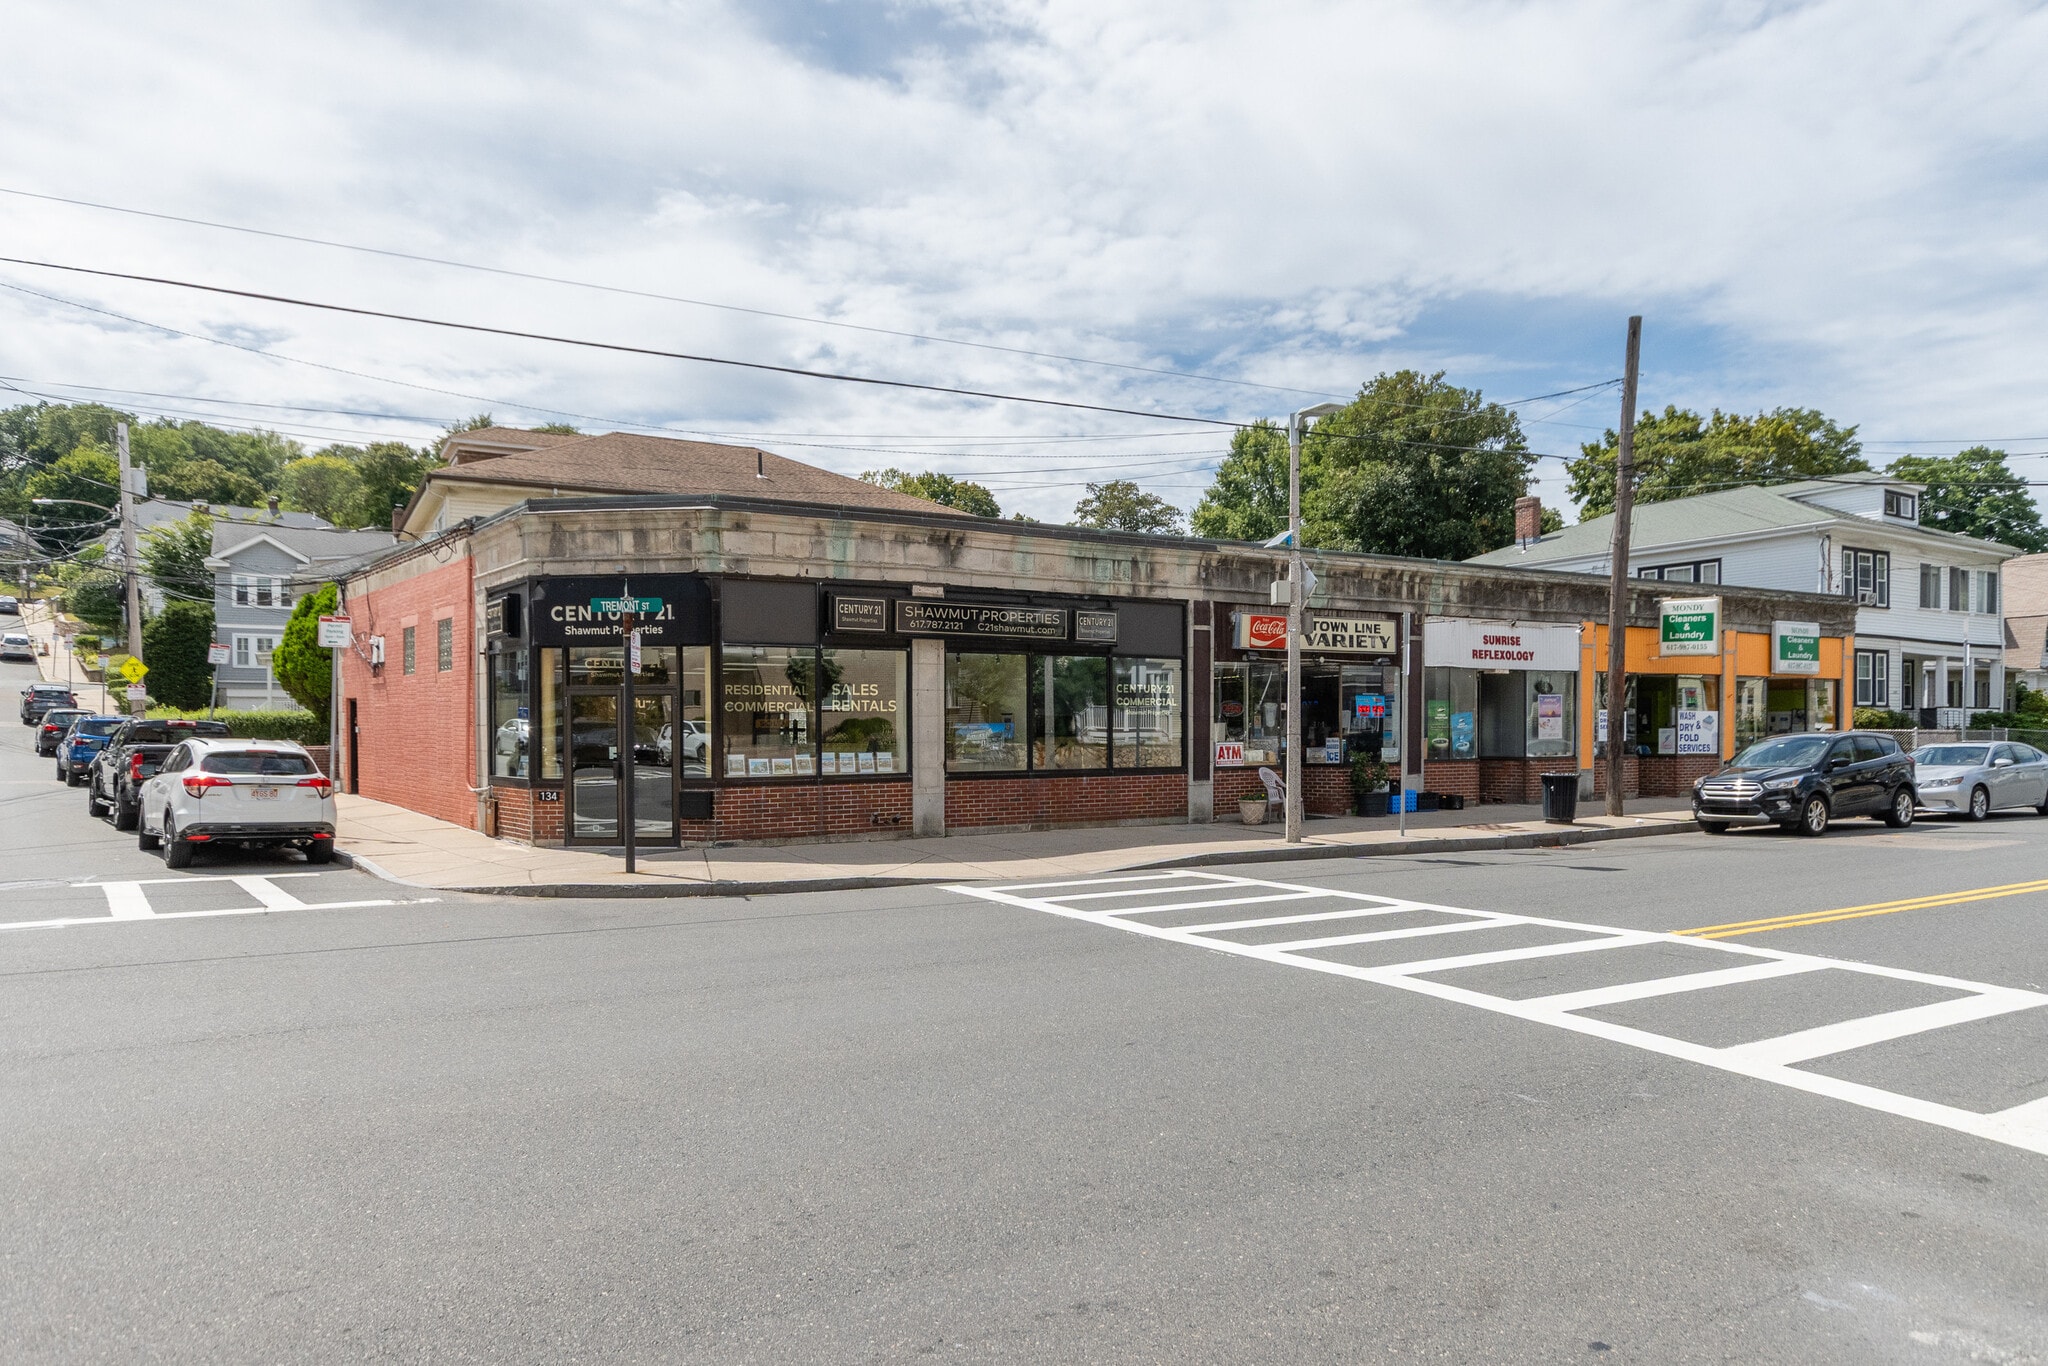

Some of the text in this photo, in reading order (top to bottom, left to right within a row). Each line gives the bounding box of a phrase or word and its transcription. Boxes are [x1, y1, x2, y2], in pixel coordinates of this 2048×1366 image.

[601, 600, 650, 611] TREMONT ST
[839, 604, 882, 615] CENTURY 21
[551, 605, 647, 621] CENTUY
[905, 606, 1060, 624] SHAWMUT PROPERTIES
[1079, 616, 1106, 626] CENTURY
[1669, 615, 1707, 623] Cleaners
[565, 625, 663, 635] Shawmut Prerties
[910, 620, 1056, 634] 617.787.2121 C21shawmut.com
[1314, 621, 1381, 634] TOWN LINE
[1683, 623, 1690, 631] &
[1304, 633, 1391, 649] VARIETY
[1482, 634, 1521, 646] SUNRISE
[1670, 631, 1705, 640] Laundry
[1472, 649, 1534, 661] REFLEXOLOGY
[1788, 651, 1813, 660] Laundry
[725, 684, 879, 696] RESIDENTIAL SALES
[1116, 684, 1175, 694] CENTURY 21
[724, 700, 897, 712] COMMERCIAL RENTALS
[1116, 697, 1177, 706] COMMERCIAL
[1679, 712, 1696, 720] WASH
[1680, 720, 1701, 731] DRY &
[1218, 745, 1242, 760] ATM
[1679, 744, 1711, 752] SERVICES
[1326, 751, 1339, 761] ICE
[540, 792, 557, 800] 134
